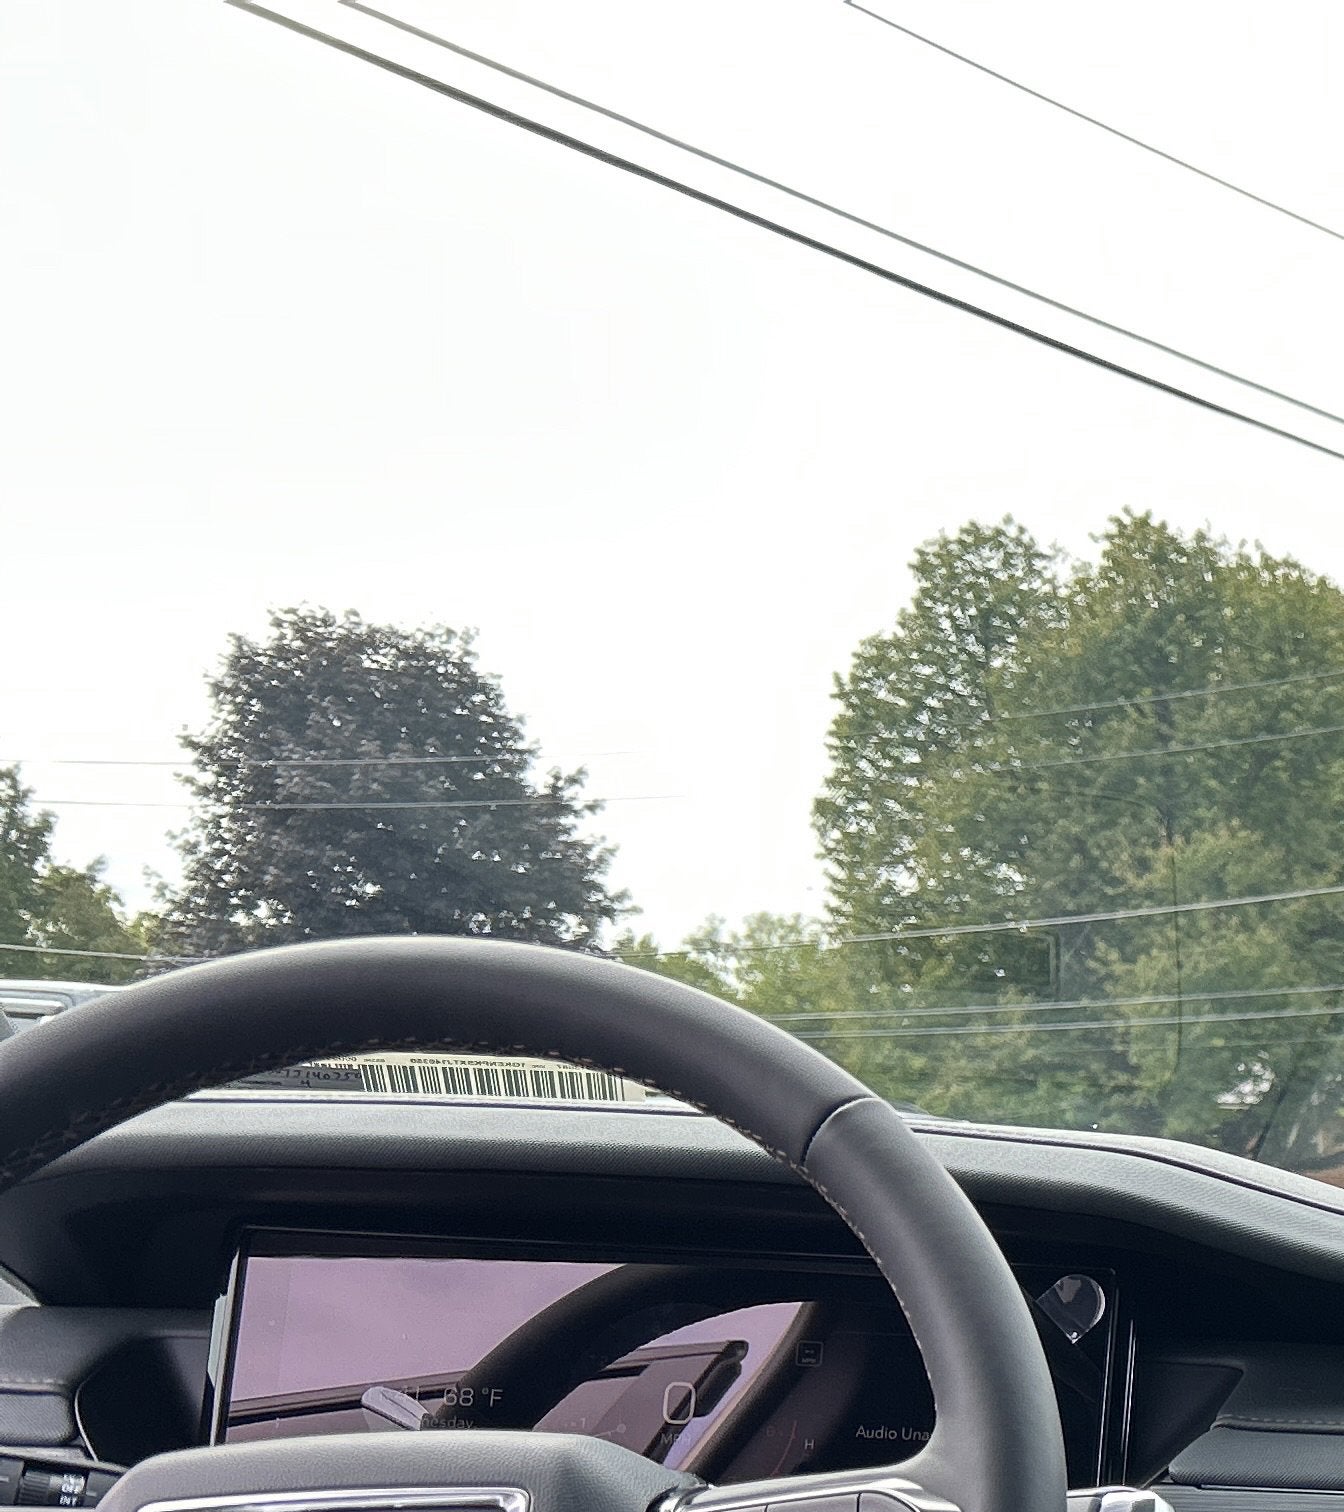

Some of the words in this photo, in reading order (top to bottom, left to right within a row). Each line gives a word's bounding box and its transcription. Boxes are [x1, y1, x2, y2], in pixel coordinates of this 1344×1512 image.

[443, 1387, 474, 1407] 68
[855, 1425, 898, 1440] Audio
[804, 1439, 815, 1450] H
